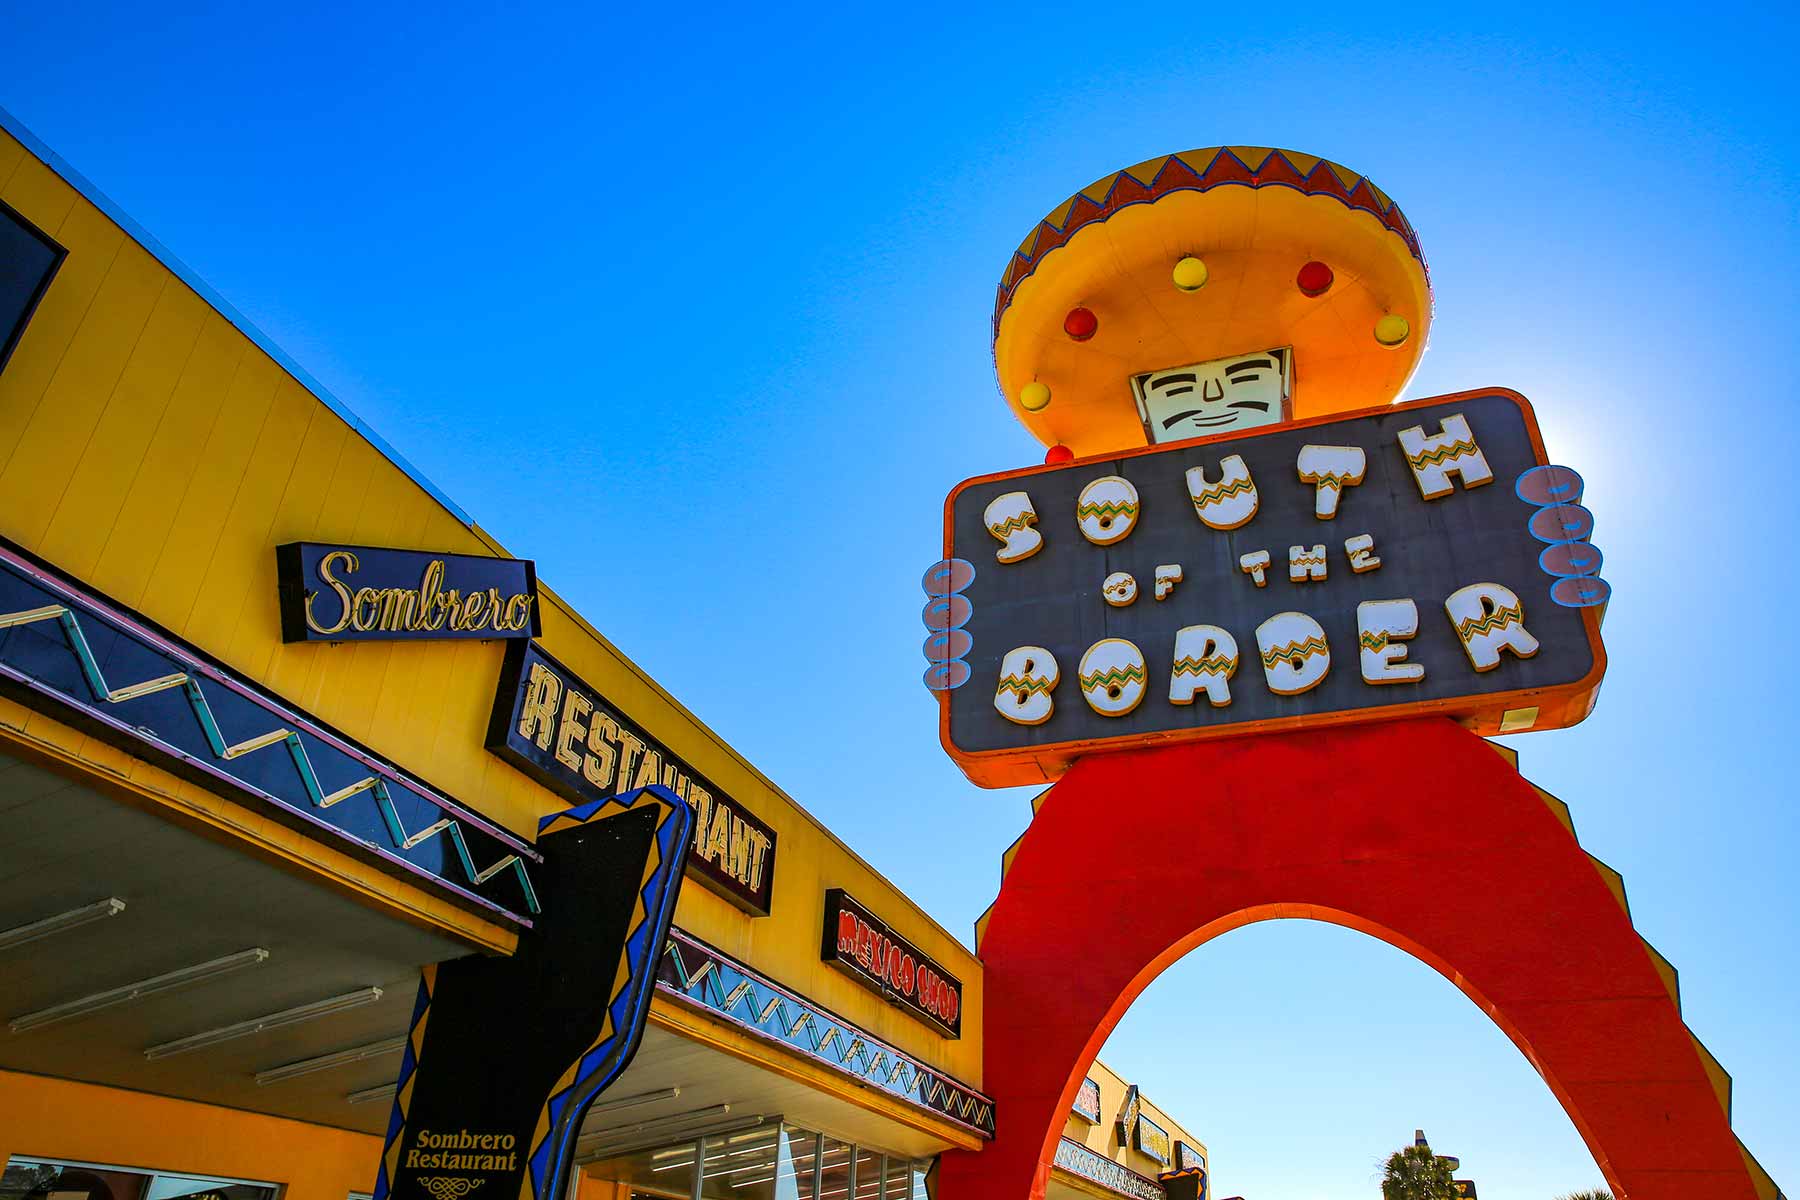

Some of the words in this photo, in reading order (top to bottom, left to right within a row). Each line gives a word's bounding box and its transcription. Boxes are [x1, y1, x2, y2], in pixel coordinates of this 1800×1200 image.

[982, 414, 1493, 563] SOUTH
[305, 551, 534, 634] Sombrero
[1102, 564, 1184, 607] OF
[1240, 534, 1382, 587] THE
[994, 582, 1539, 725] BORDER
[838, 909, 914, 996] MEXICO
[405, 1150, 517, 1171] Restaurant
[417, 1129, 515, 1149] Sombrero
